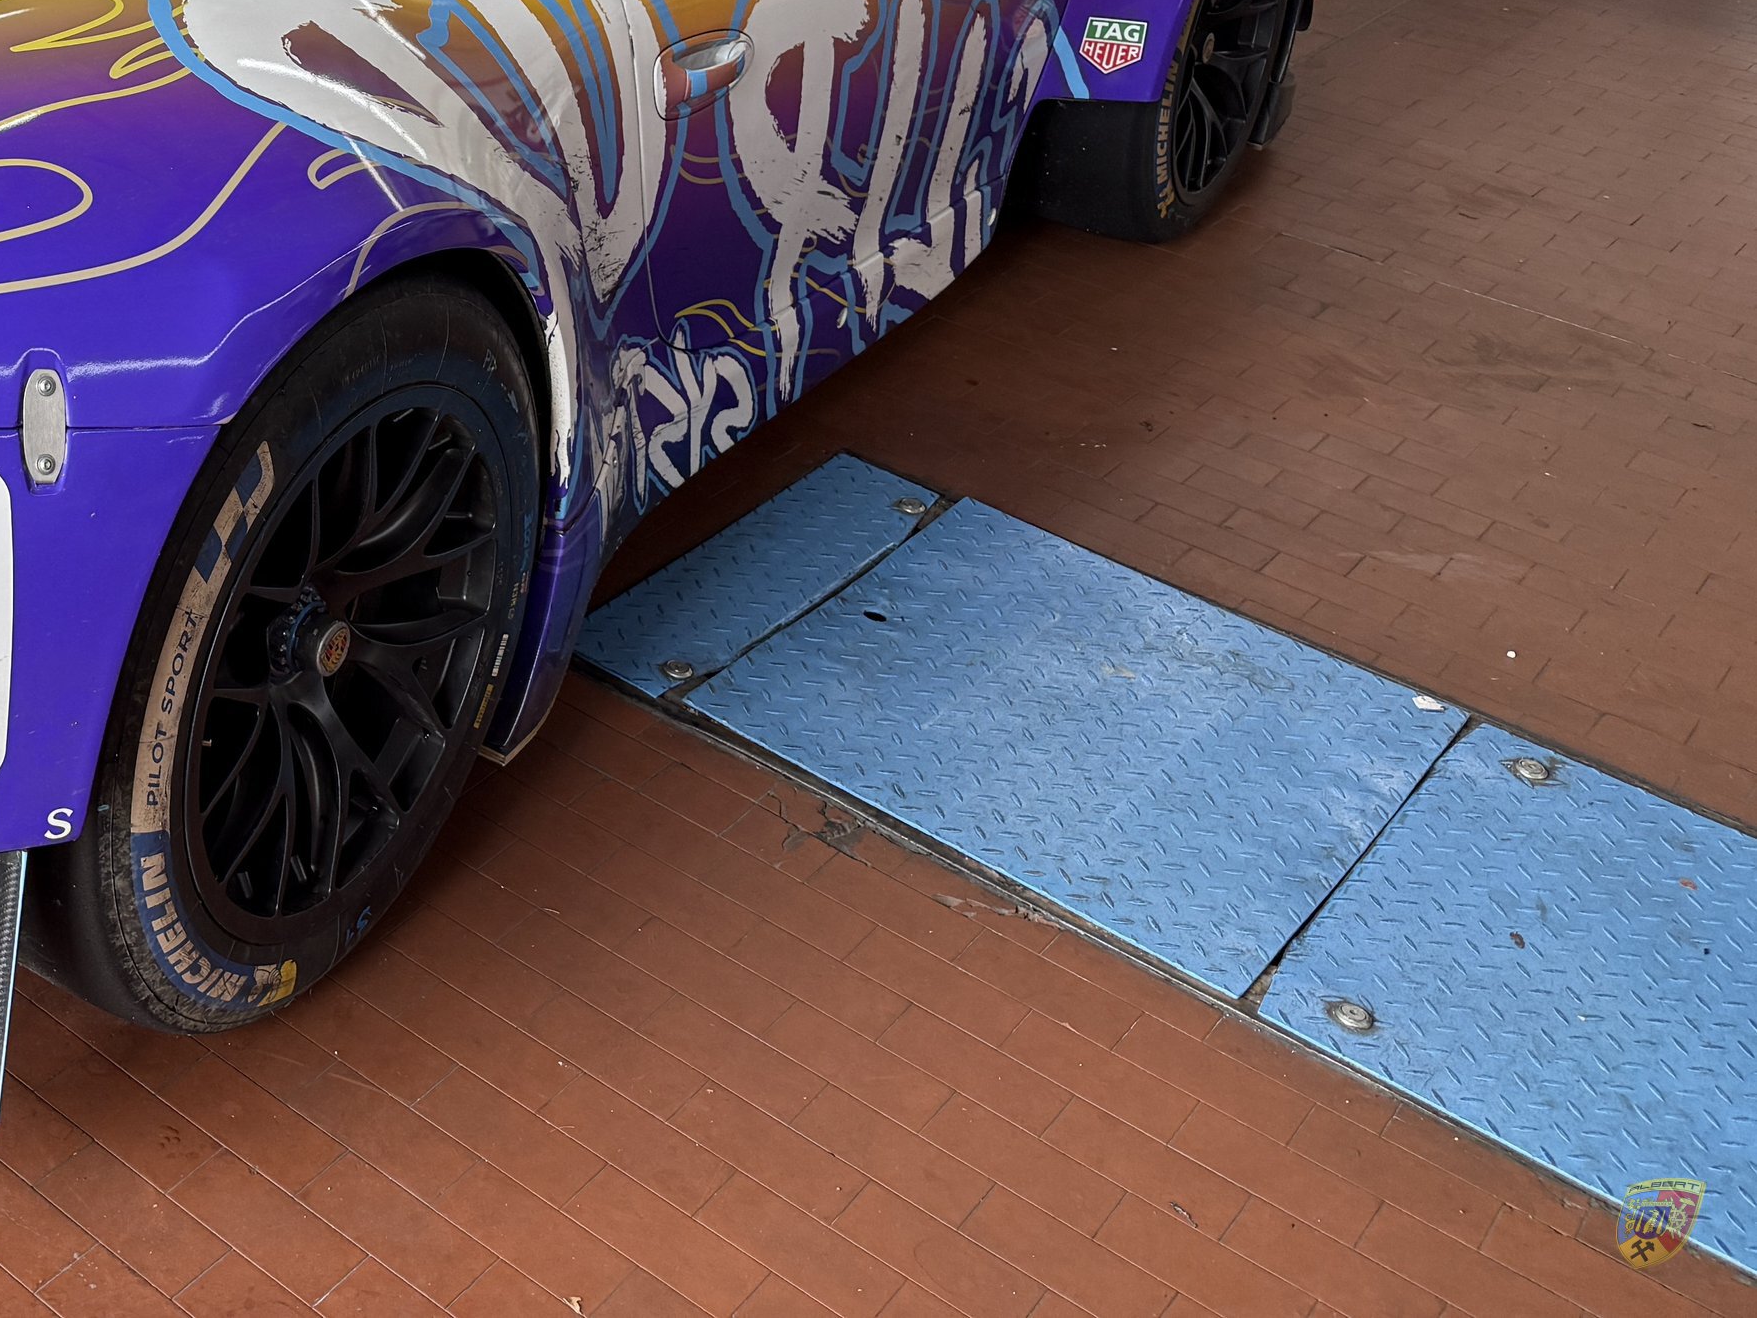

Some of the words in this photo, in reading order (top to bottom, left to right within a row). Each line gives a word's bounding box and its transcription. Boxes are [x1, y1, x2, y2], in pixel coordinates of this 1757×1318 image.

[1083, 42, 1139, 69] HEUER
[1092, 21, 1141, 42] TAG
[1156, 58, 1180, 186] MICHELIN
[147, 721, 167, 807] PILOT
[161, 609, 198, 715] SPORT
[140, 851, 249, 1003] MICHELIN
